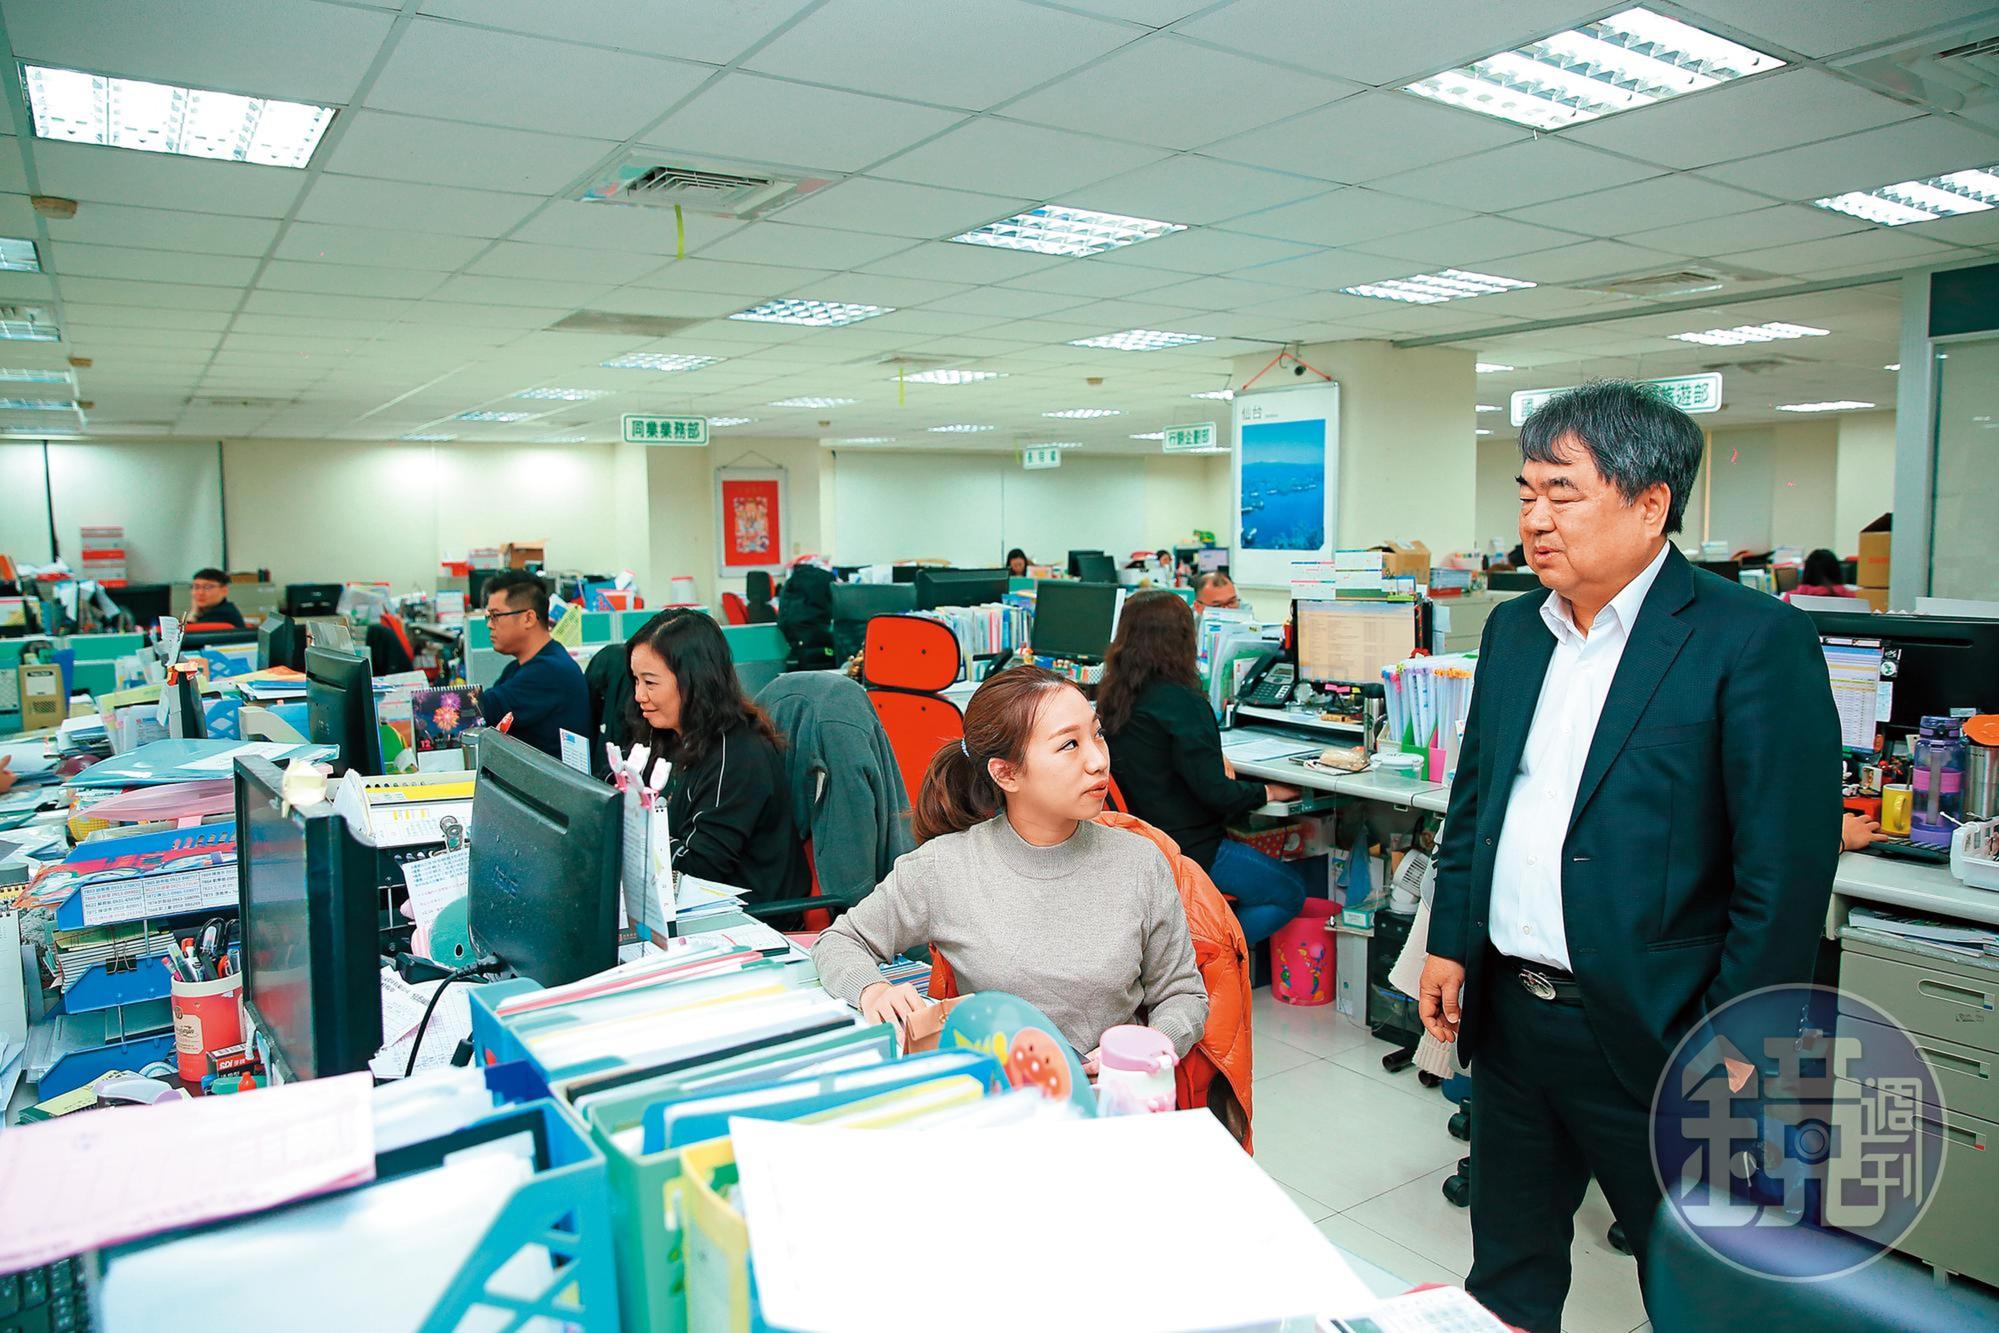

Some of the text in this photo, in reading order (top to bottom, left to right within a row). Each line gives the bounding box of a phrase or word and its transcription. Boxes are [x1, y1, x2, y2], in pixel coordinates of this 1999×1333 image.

[631, 420, 700, 439] 同業業務部
[420, 740, 431, 750] 12
